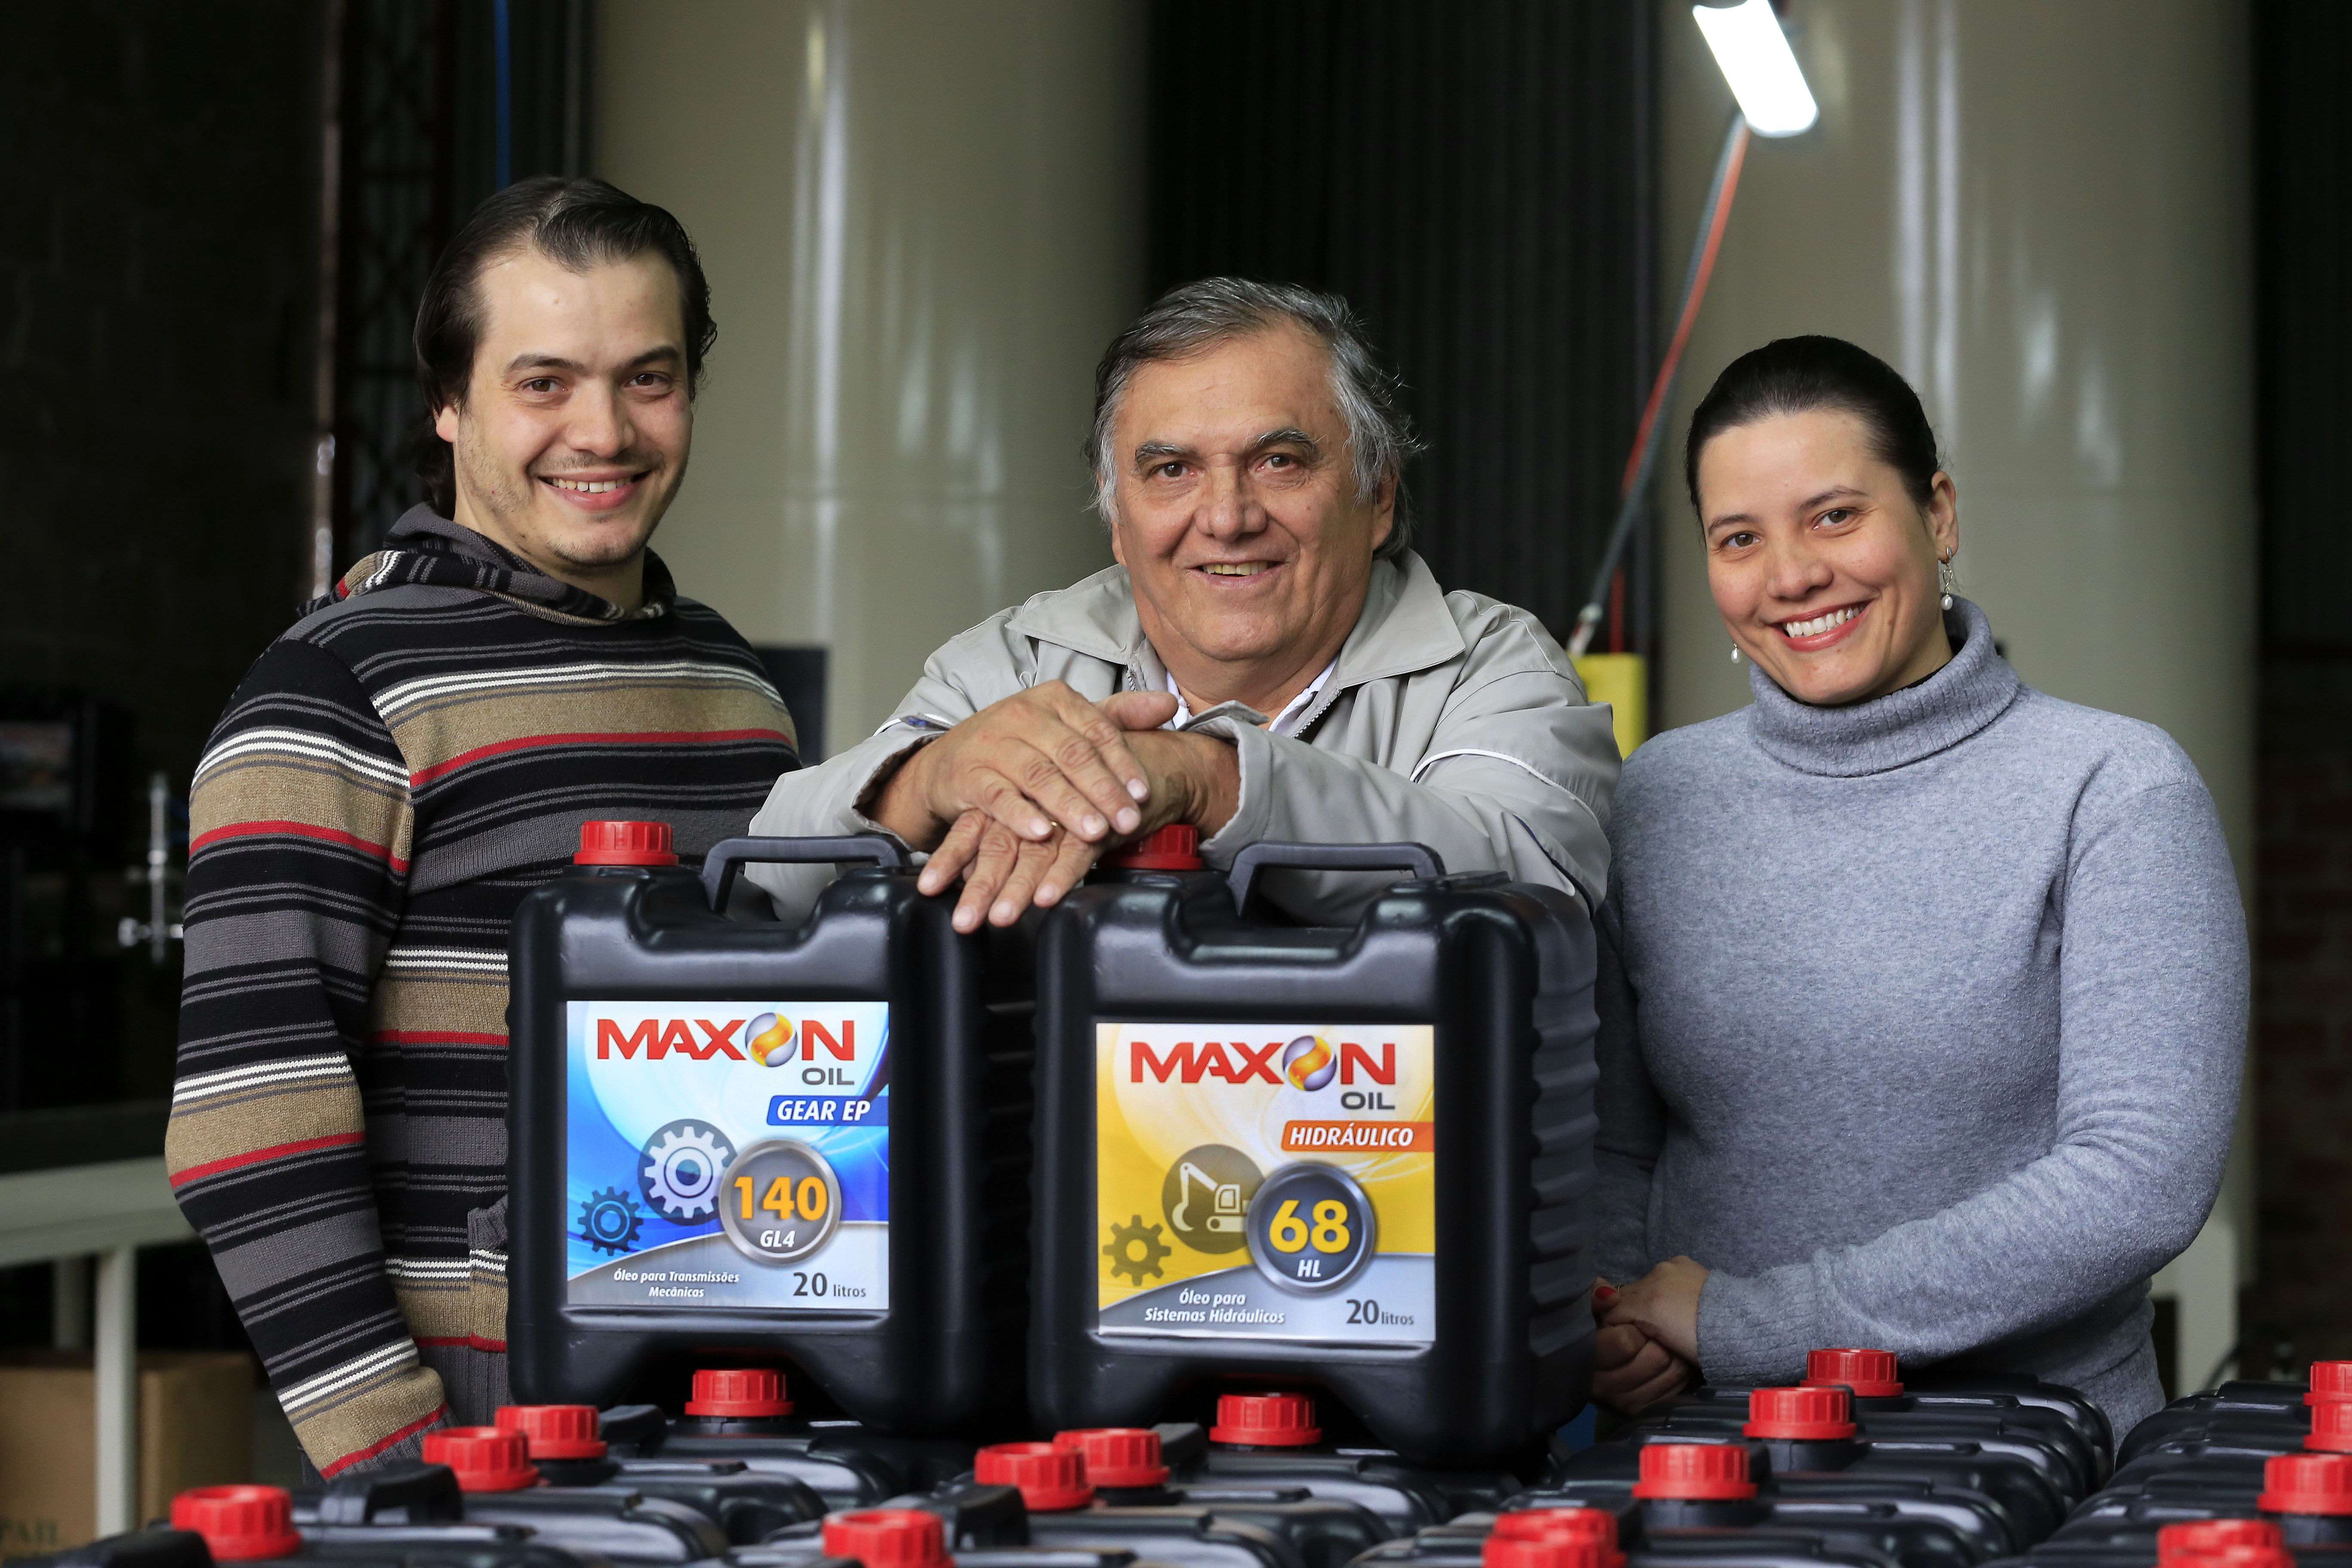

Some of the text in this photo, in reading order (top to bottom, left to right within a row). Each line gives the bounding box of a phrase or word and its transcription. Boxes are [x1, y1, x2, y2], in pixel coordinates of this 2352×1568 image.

[802, 1068, 854, 1085] OIL
[1341, 1092, 1396, 1110] OIL
[777, 1100, 871, 1121] GEAR EP
[1290, 1122, 1414, 1147] HIDRÁULICO
[733, 1176, 827, 1221] 140
[1268, 1200, 1350, 1254] 68
[760, 1229, 796, 1248] GL4
[613, 1268, 740, 1284] Óleo para Transmissões
[1297, 1259, 1321, 1277] HL
[649, 1285, 704, 1298] Mecânicas
[793, 1272, 866, 1297] 20 litros
[1179, 1289, 1246, 1307] Óleo para
[1145, 1308, 1285, 1324] Sistemas Hidráulicos
[1346, 1299, 1414, 1325] 20 litros
